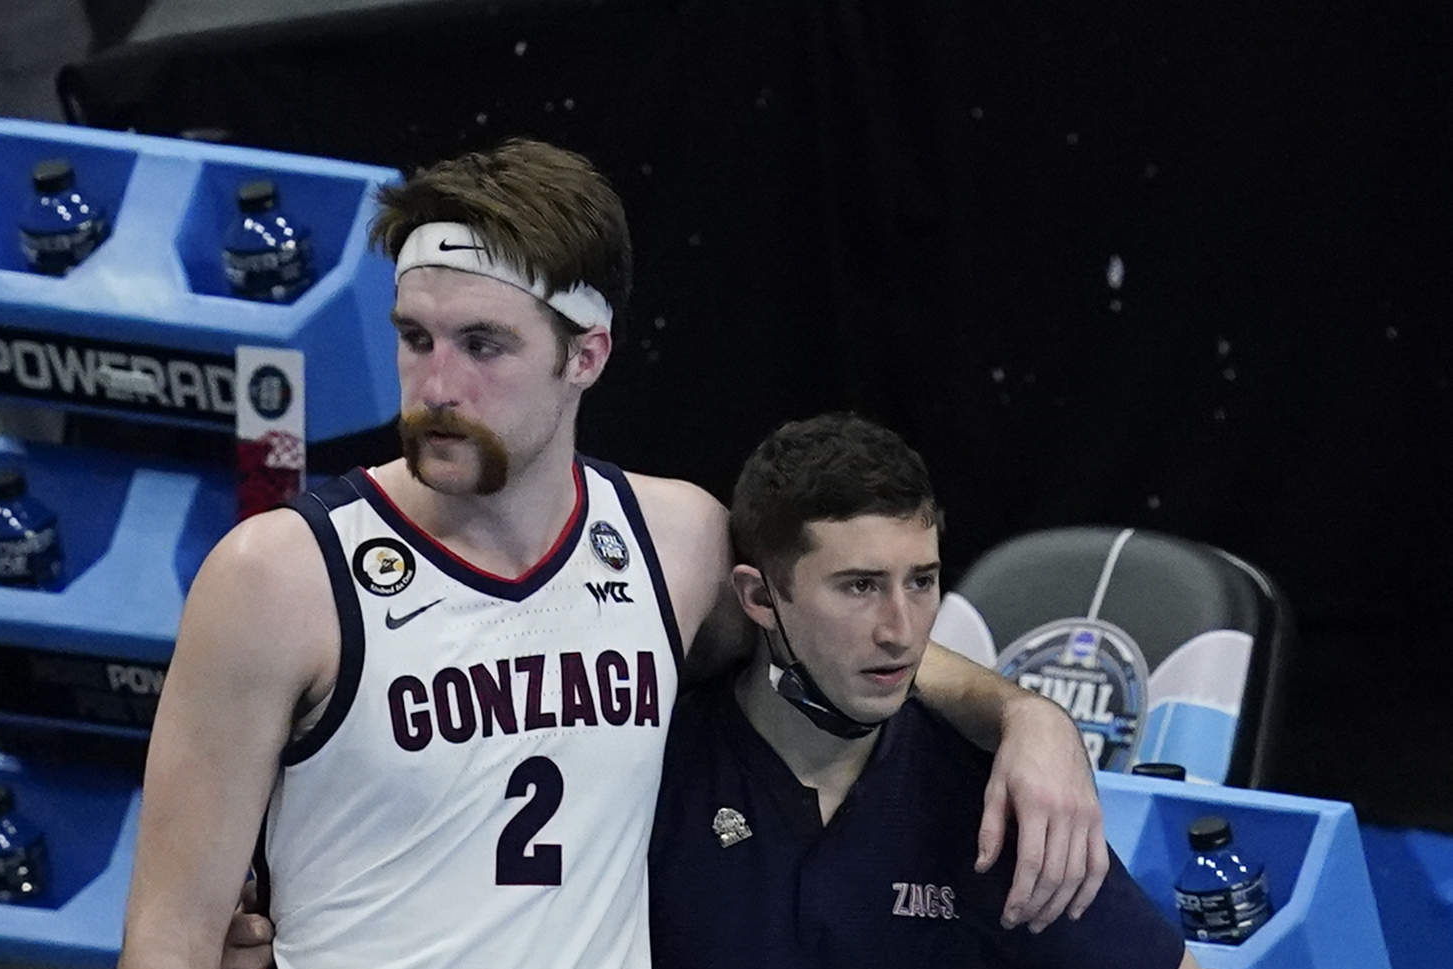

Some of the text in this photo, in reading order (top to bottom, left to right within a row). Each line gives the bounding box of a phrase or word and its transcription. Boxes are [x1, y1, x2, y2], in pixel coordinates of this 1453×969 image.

[387, 650, 660, 752] GONZAGA
[495, 755, 564, 886] 2
[892, 882, 955, 920] ZAGS
